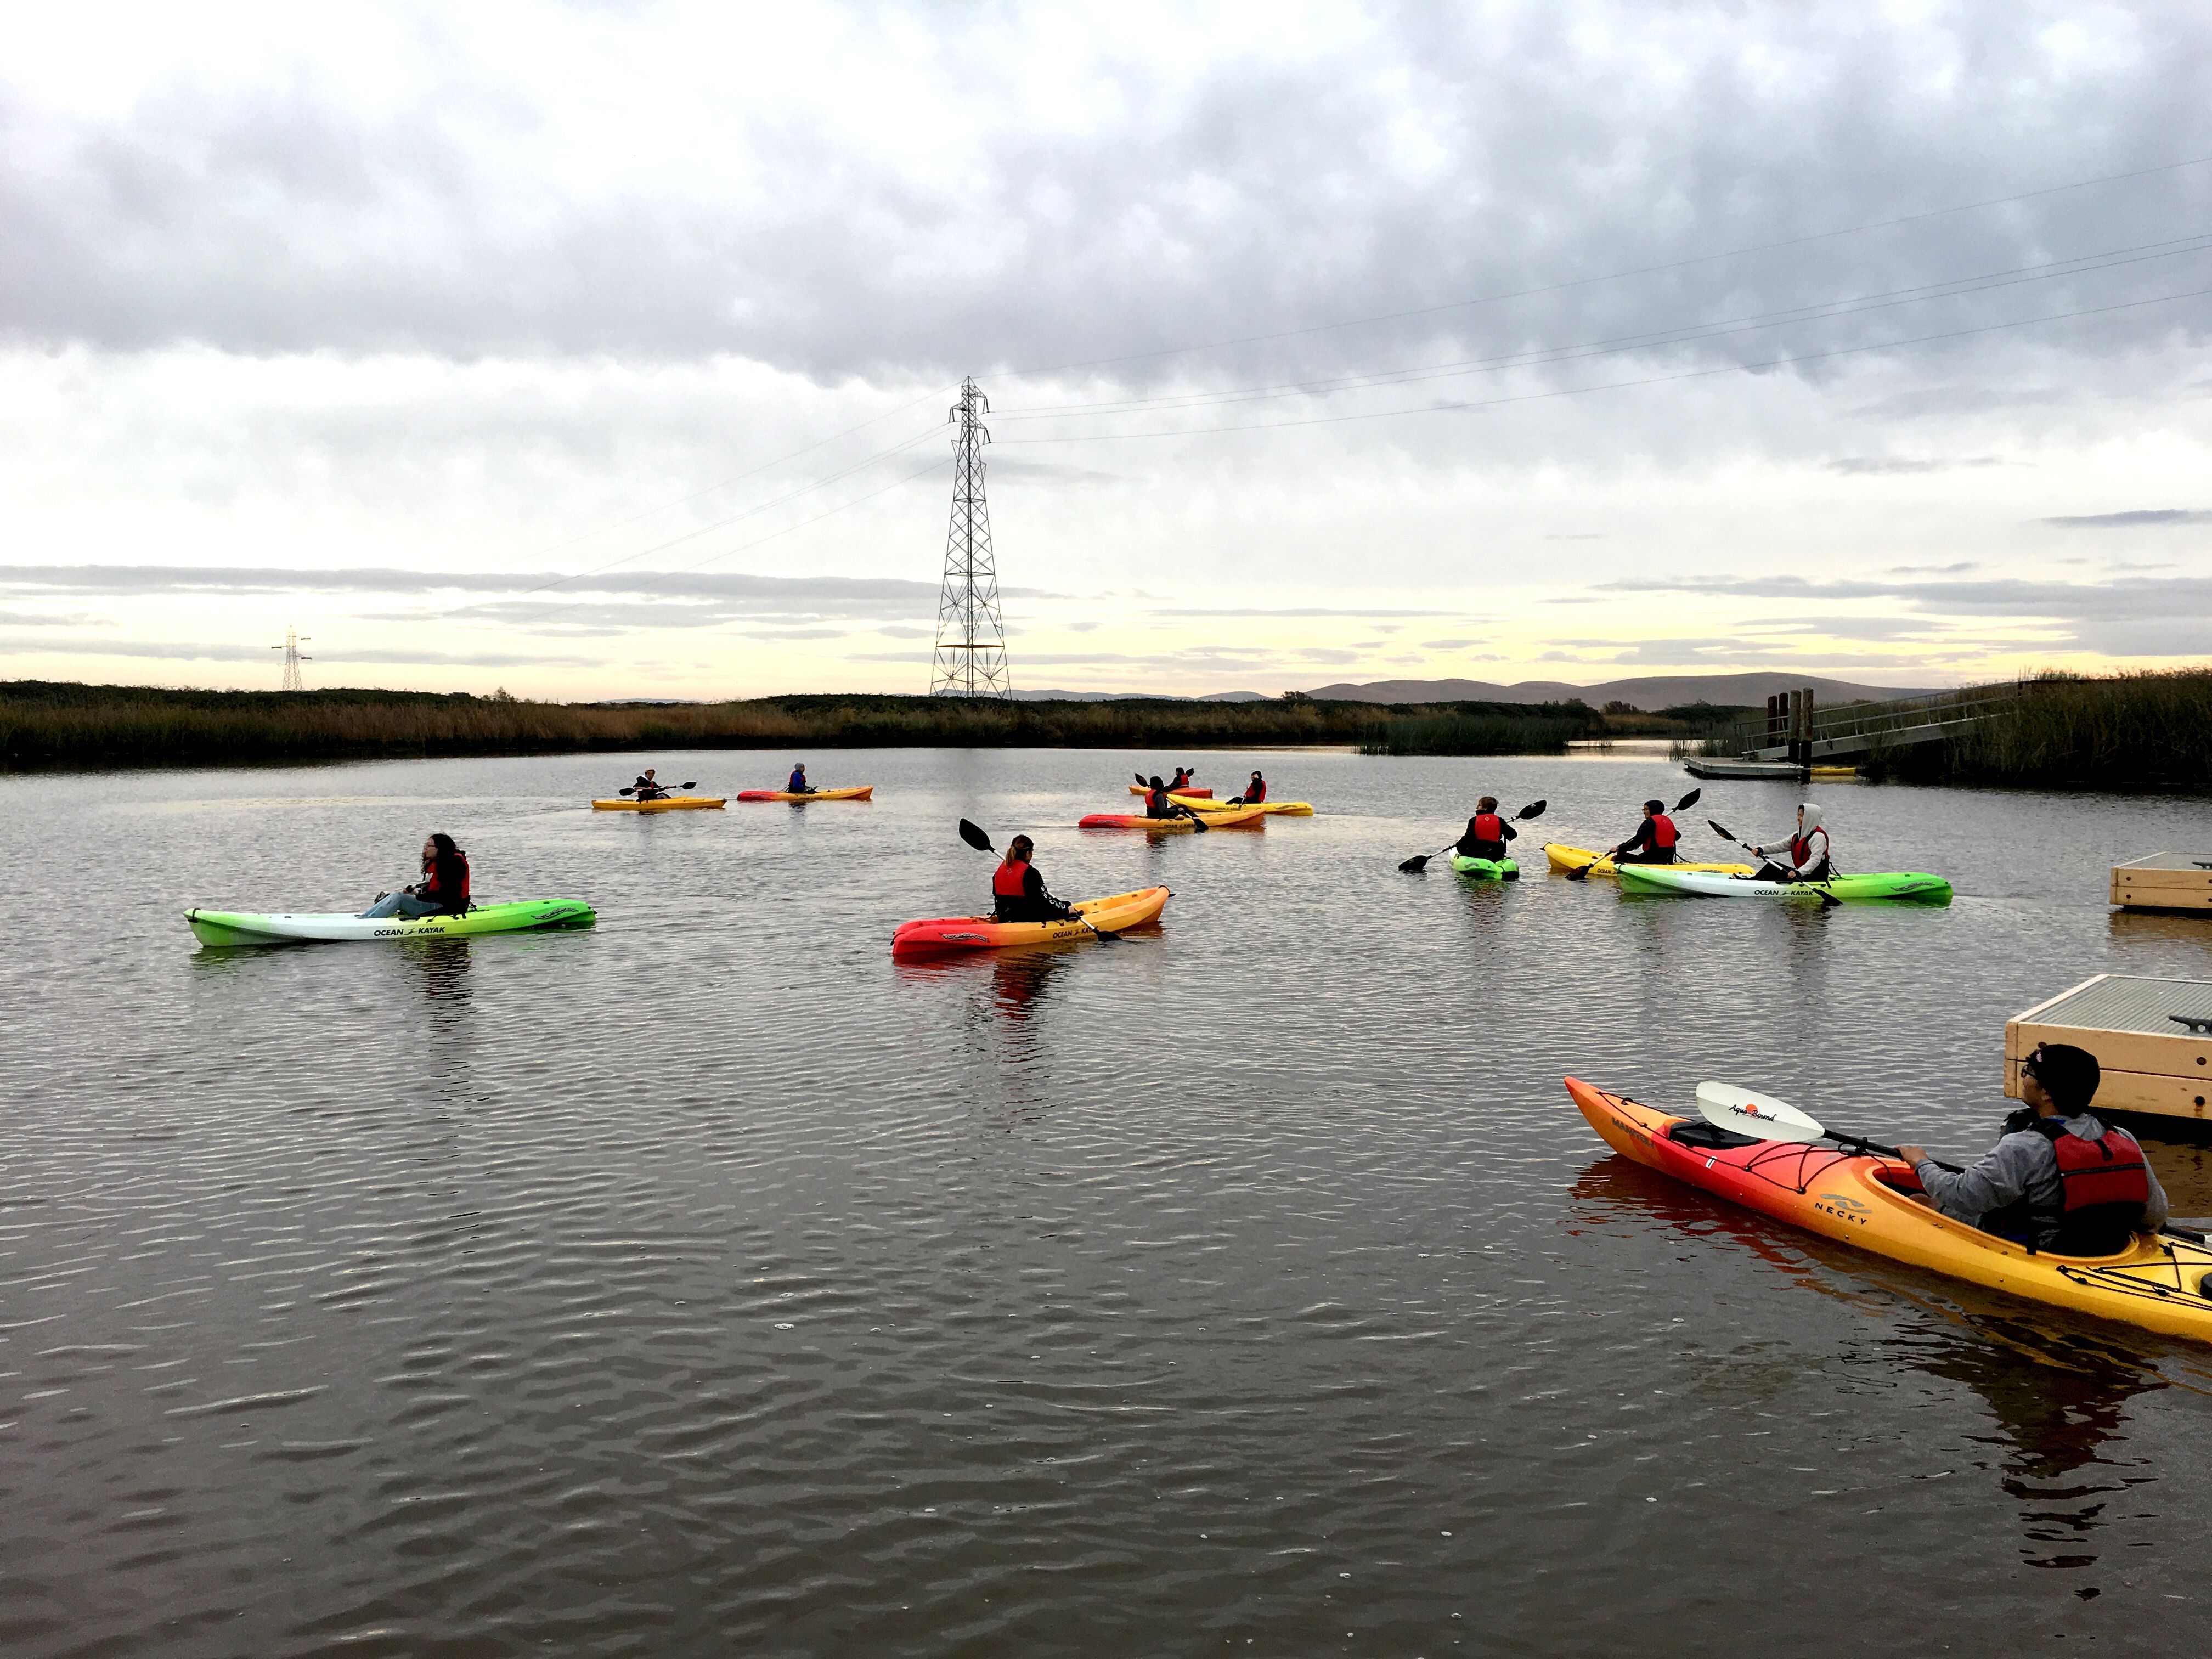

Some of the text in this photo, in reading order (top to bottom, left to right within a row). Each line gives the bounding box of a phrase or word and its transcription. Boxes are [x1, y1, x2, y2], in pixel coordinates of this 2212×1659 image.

[1053, 930, 1073, 938] OCEAN
[1729, 1104, 1777, 1122] Aqua-Bound
[1815, 1202, 1867, 1225] NECKY
